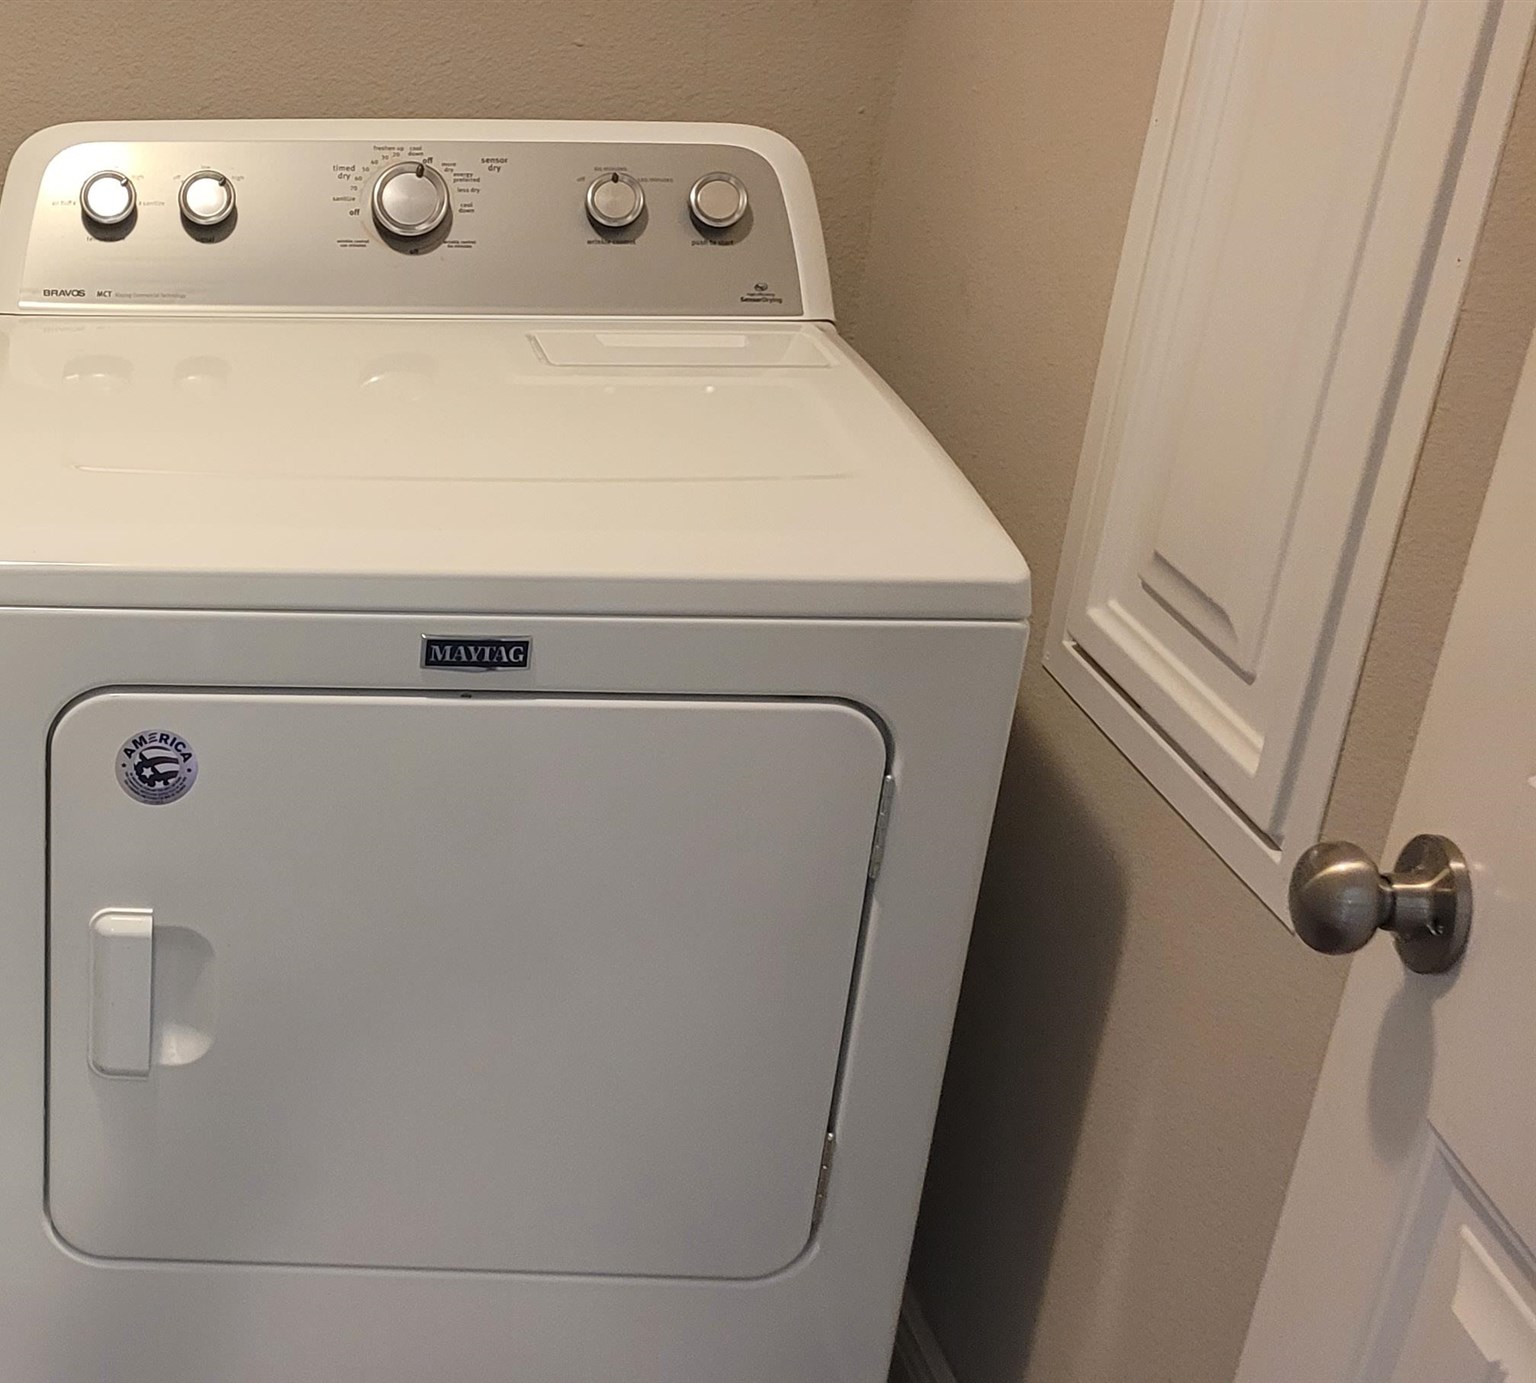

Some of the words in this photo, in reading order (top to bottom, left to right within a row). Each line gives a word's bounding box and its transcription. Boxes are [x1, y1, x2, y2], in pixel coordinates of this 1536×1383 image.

[488, 164, 501, 172] dry
[43, 289, 86, 297] BRAVOS
[97, 290, 112, 298] MCT
[430, 645, 524, 662] MAYTAG
[123, 732, 193, 763] AMERICA
